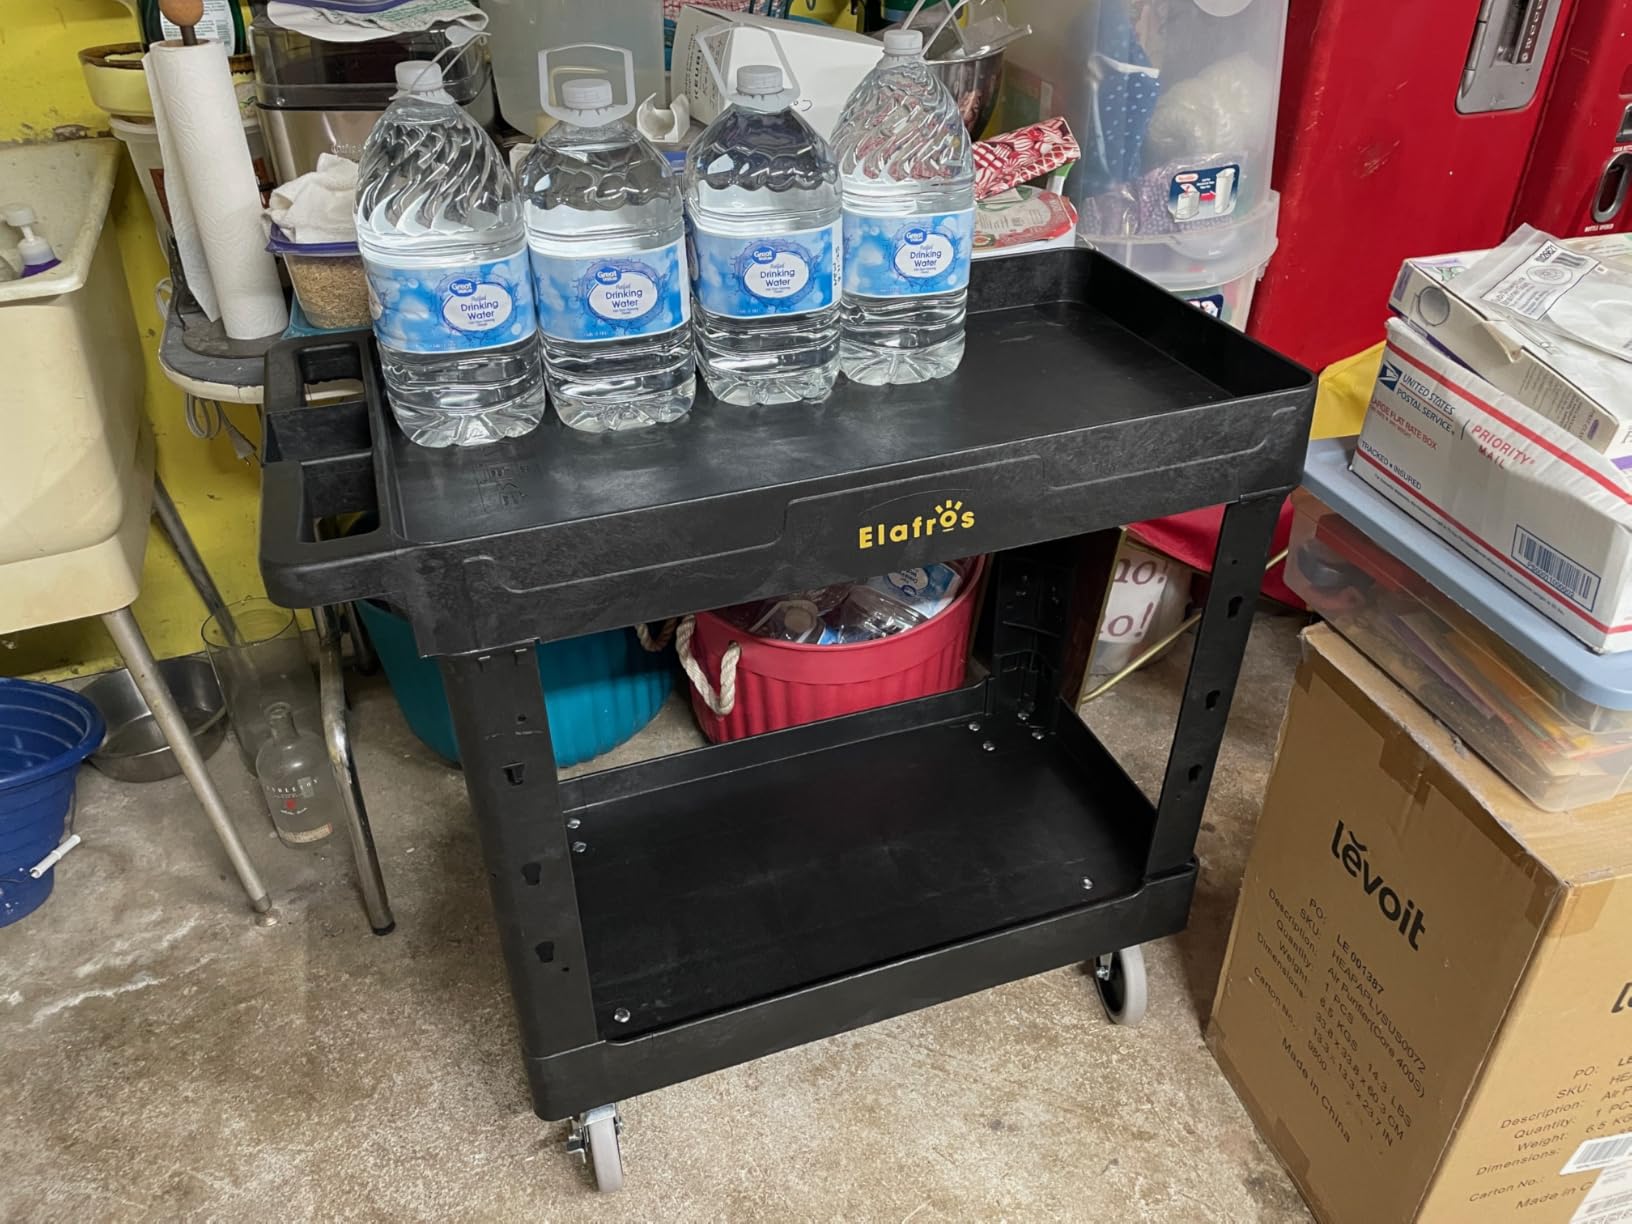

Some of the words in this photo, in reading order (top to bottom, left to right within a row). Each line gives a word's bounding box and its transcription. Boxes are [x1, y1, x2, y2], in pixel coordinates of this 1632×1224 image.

[910, 250, 942, 259] Drinking
[914, 259, 937, 267] Water
[760, 269, 796, 279] Drinking
[766, 279, 790, 287] Water
[451, 282, 472, 290] Great
[605, 289, 643, 300] Drinking
[460, 301, 499, 312] Drinking
[612, 299, 638, 308] Water
[467, 311, 495, 320] Water
[1397, 388, 1421, 411] POSTAL
[1403, 374, 1430, 397] UNITED
[1428, 393, 1456, 415] STATES
[1390, 410, 1405, 426] FLAT
[1404, 422, 1422, 439] RATE
[1422, 433, 1438, 451] BOX
[1361, 440, 1389, 466] TRACKED
[1393, 464, 1422, 490] INSURED
[1478, 445, 1505, 470] MAIL
[858, 502, 975, 549] Elafros
[1309, 898, 1326, 925] PO:
[1336, 934, 1350, 954] LE
[1277, 919, 1313, 972] Quantity:
[1333, 993, 1354, 1025] PCS
[1254, 966, 1280, 1007] Carton
[1269, 888, 1317, 956] Description:
[1327, 967, 1340, 983] Air
[1396, 1058, 1425, 1098] 400S)
[1300, 908, 1320, 940] SKU:
[1331, 949, 1426, 1074] HEAPAPLVSUS0072
[1336, 1020, 1358, 1052] KGS
[1391, 1095, 1411, 1128] LBS
[1573, 1065, 1600, 1079] PO:
[1282, 1037, 1308, 1079] Made
[1310, 1077, 1319, 1096] in
[1321, 1095, 1351, 1143] China
[1556, 1083, 1592, 1099] SKU:
[1500, 1100, 1585, 1129] Description:
[1382, 1128, 1393, 1147] IN
[1387, 1114, 1404, 1140] CM
[1514, 1117, 1576, 1139] Quantity:
[1517, 1132, 1569, 1152] Weight:
[1476, 1147, 1561, 1176] Dimensions:
[1469, 1184, 1514, 1202] Carton
[1515, 1190, 1559, 1210] Made
[1562, 1186, 1576, 1198] in
